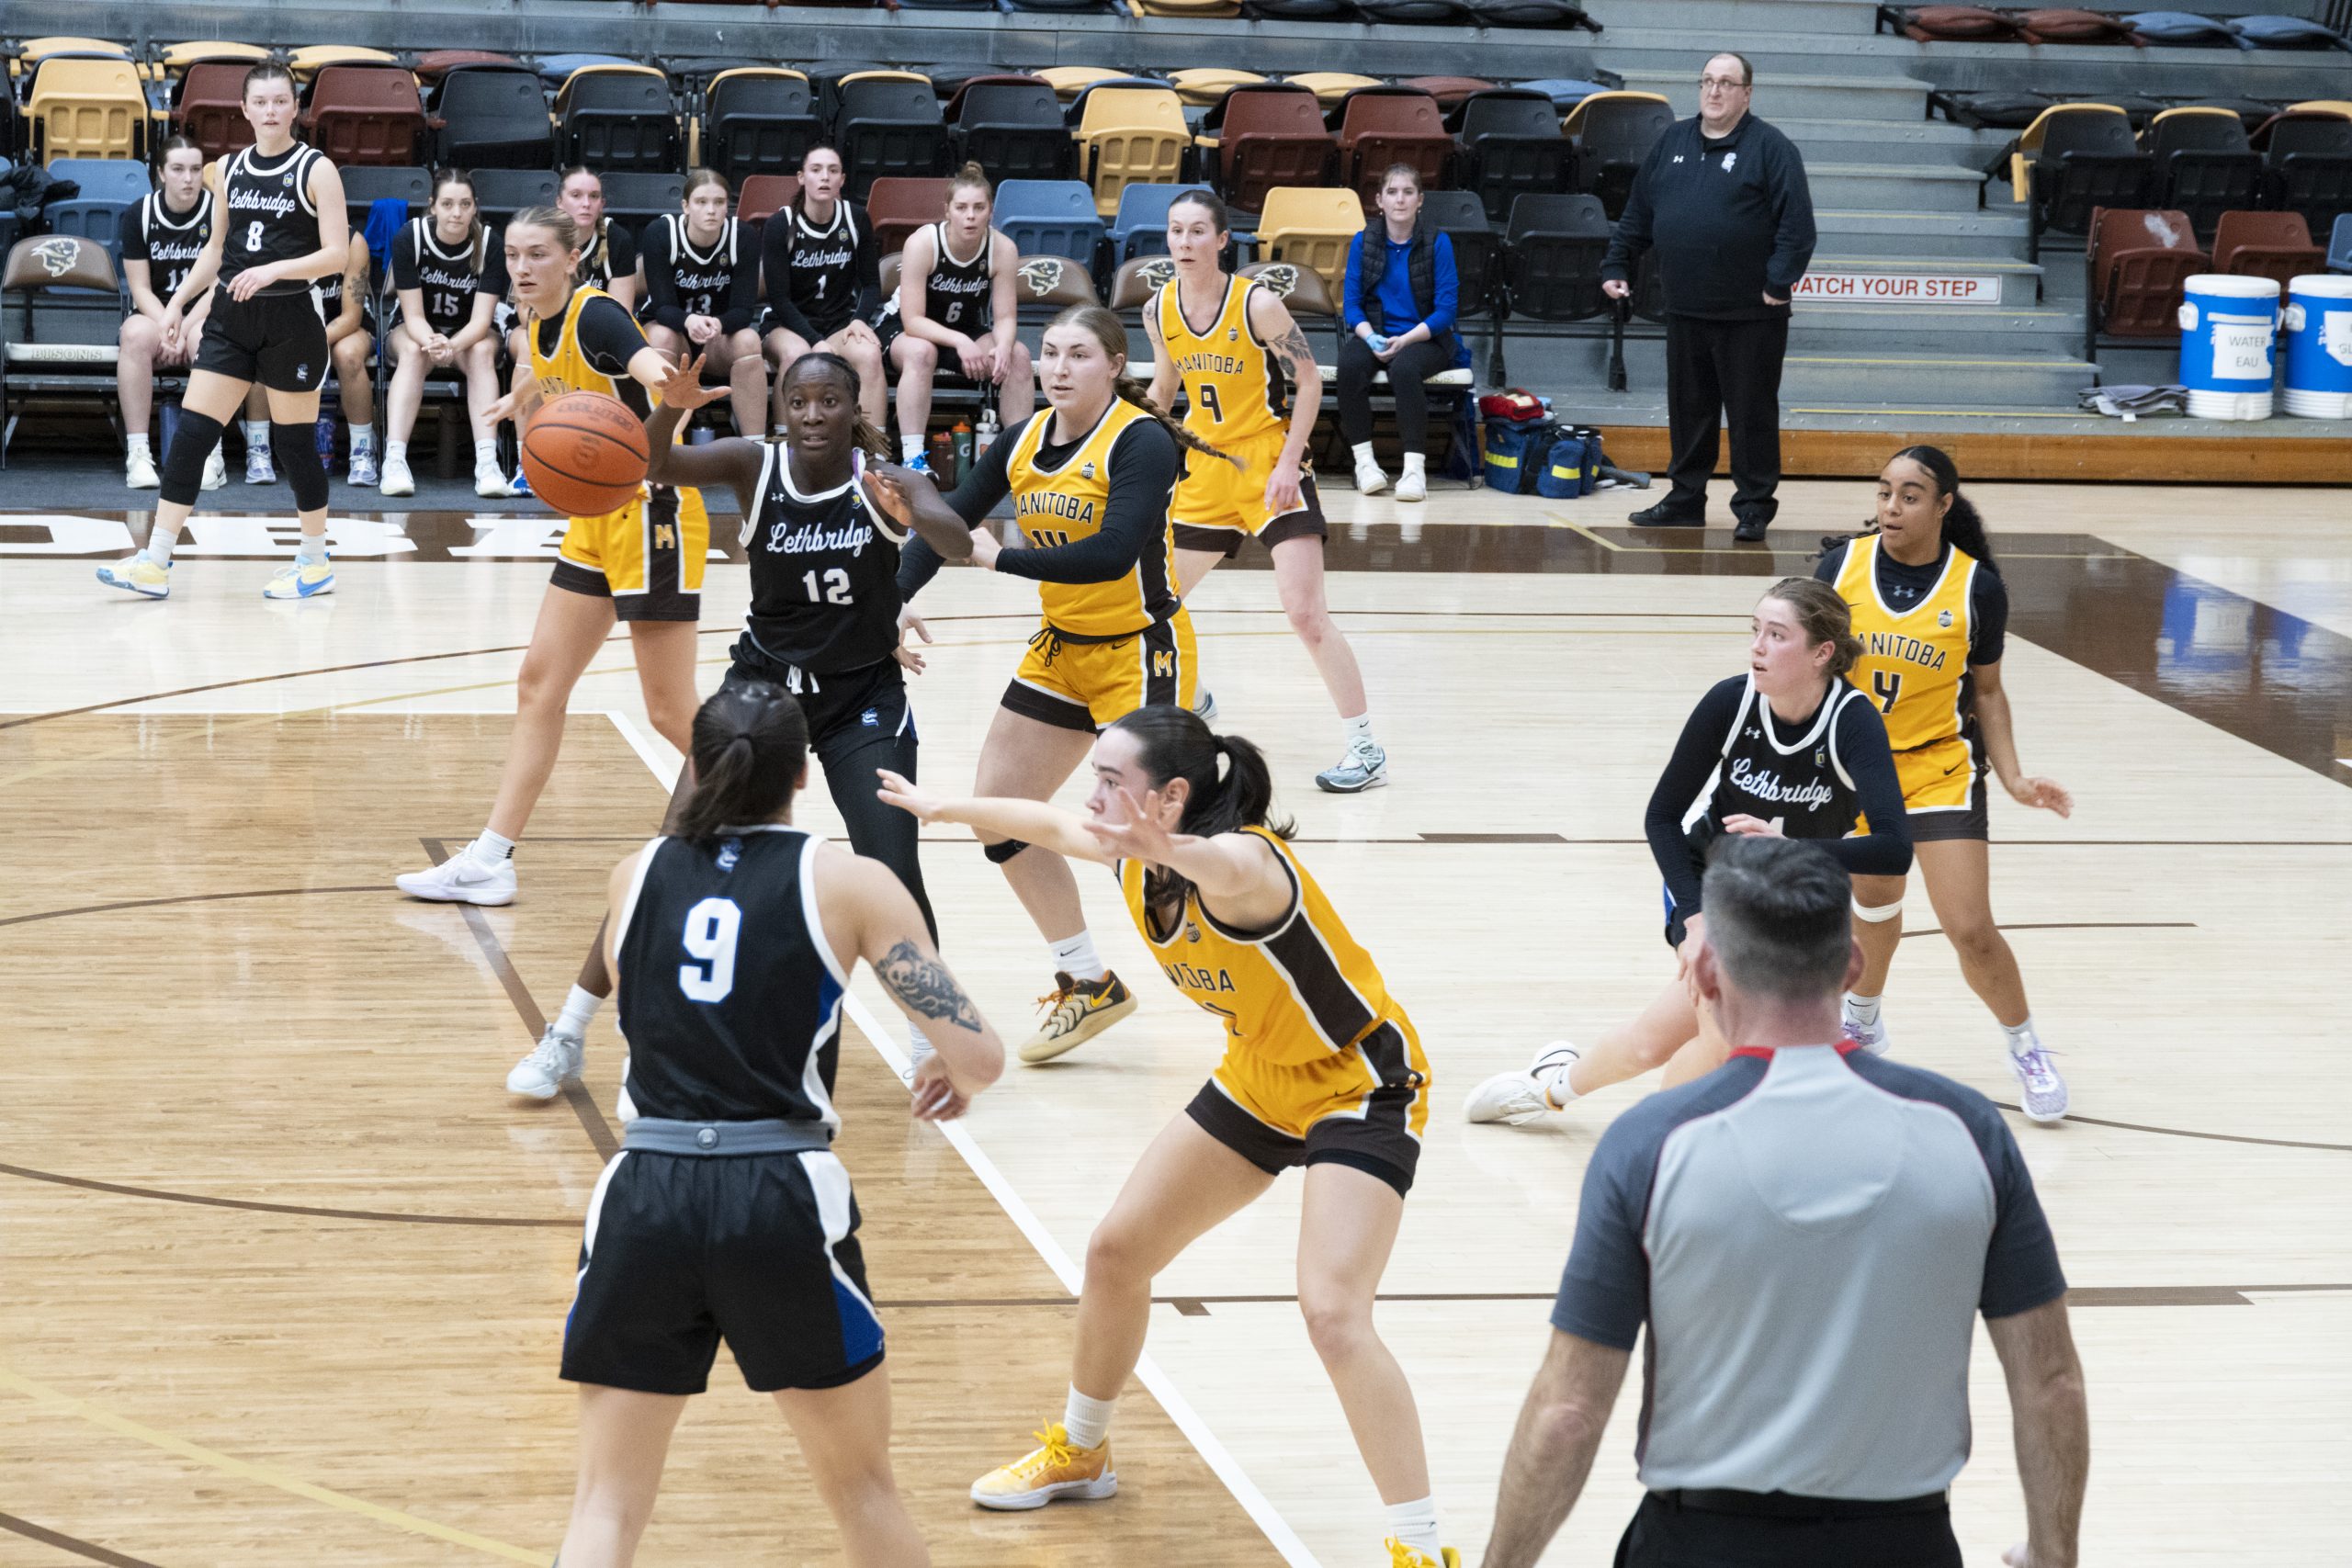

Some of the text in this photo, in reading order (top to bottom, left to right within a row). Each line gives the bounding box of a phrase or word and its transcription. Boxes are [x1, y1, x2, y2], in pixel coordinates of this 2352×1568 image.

[228, 187, 296, 219] Lethbridge
[246, 220, 265, 252] 8
[150, 241, 201, 260] Lethbrid
[791, 246, 853, 270] Lethbridge
[421, 266, 478, 294] Lethbridge
[815, 275, 827, 299] 1
[928, 273, 989, 298] Lethbridge
[1862, 278, 1918, 296] YOUR
[1925, 280, 1978, 297] STEP
[432, 292, 459, 317] 15
[685, 293, 712, 315] 13
[945, 301, 964, 323] 6
[2229, 335, 2267, 347] WATER
[31, 348, 102, 360] BISONS
[2235, 355, 2259, 368] EAU
[1200, 383, 1225, 423] 9
[654, 524, 675, 549] M
[766, 518, 874, 558] Lethbridge
[802, 568, 854, 605] 12
[1154, 650, 1173, 677] M
[1858, 632, 1947, 672] ANITOBA
[1872, 670, 1902, 714] 4
[1729, 758, 1833, 812] Lethbridge
[678, 896, 742, 1004] 9
